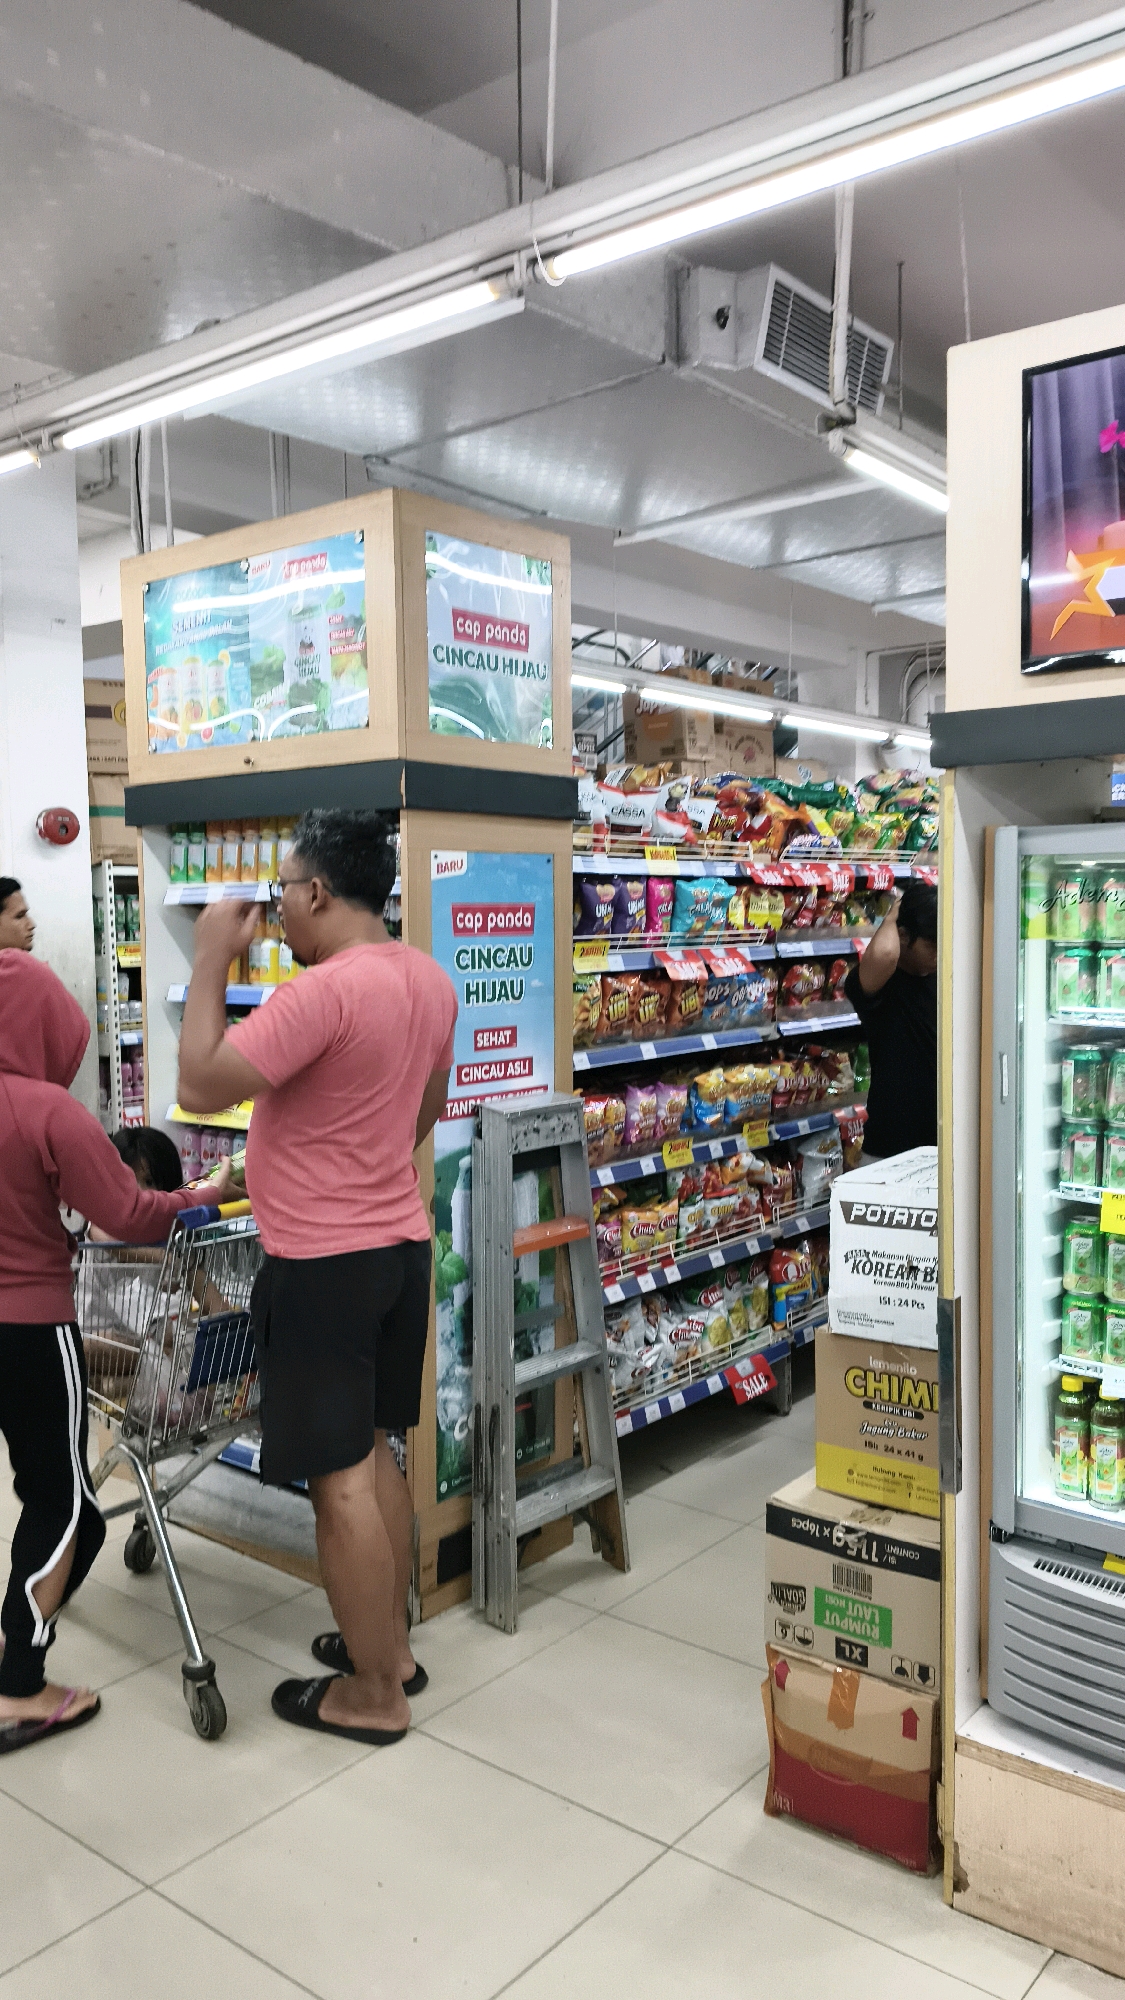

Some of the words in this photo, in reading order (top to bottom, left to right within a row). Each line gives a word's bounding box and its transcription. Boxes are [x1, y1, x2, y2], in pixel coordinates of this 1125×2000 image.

[456, 616, 480, 641] cap
[485, 621, 526, 647] panda
[432, 643, 499, 673] CINCAU
[501, 656, 547, 681] HIJAU
[611, 805, 645, 818] CASSA
[436, 859, 464, 875] BARU
[456, 912, 483, 934] cap
[487, 907, 532, 934] panda
[455, 945, 533, 971] CINCAU
[465, 978, 524, 1005] HIJAU
[476, 1030, 512, 1048] SEHAT
[461, 1063, 504, 1083] CINCAU
[506, 1060, 529, 1076] ASLI
[850, 1203, 938, 1228] POTATO
[851, 1259, 919, 1282] KOREAN
[898, 1298, 909, 1308] 24
[869, 1356, 917, 1375] lemonilo
[742, 1372, 767, 1397] SALE
[884, 1444, 894, 1453] 24
[823, 1608, 880, 1640] RUMPUT
[846, 1603, 880, 1625] LAUT
[840, 1642, 863, 1662] XL
